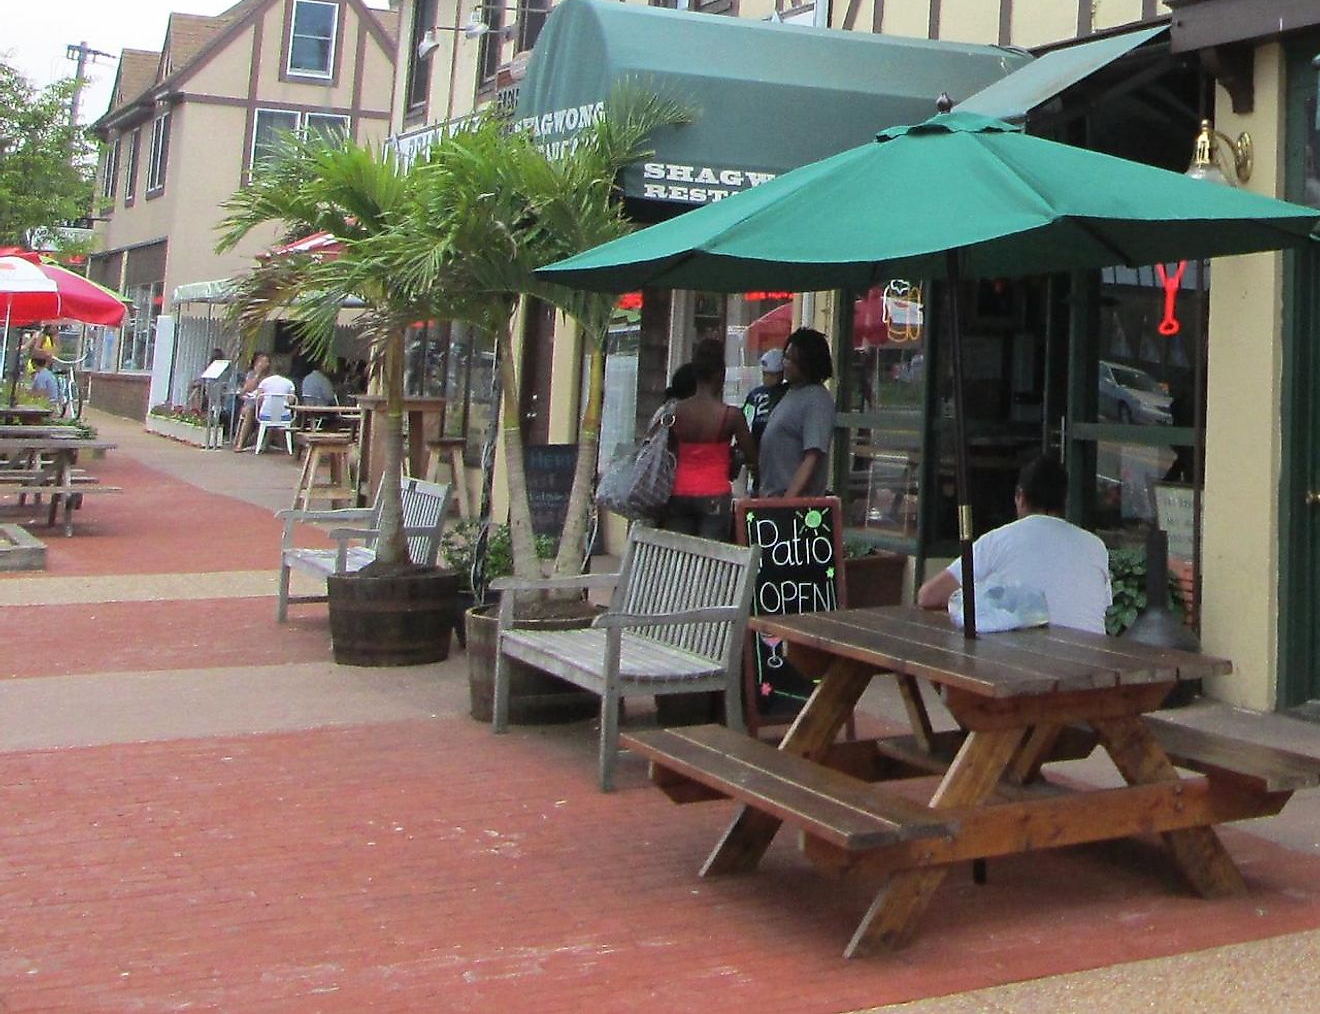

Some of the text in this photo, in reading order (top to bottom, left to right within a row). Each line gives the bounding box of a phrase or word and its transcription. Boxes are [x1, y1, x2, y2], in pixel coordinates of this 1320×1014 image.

[644, 183, 740, 202] REST
[756, 518, 833, 568] Patio
[759, 580, 830, 616] OPEN
